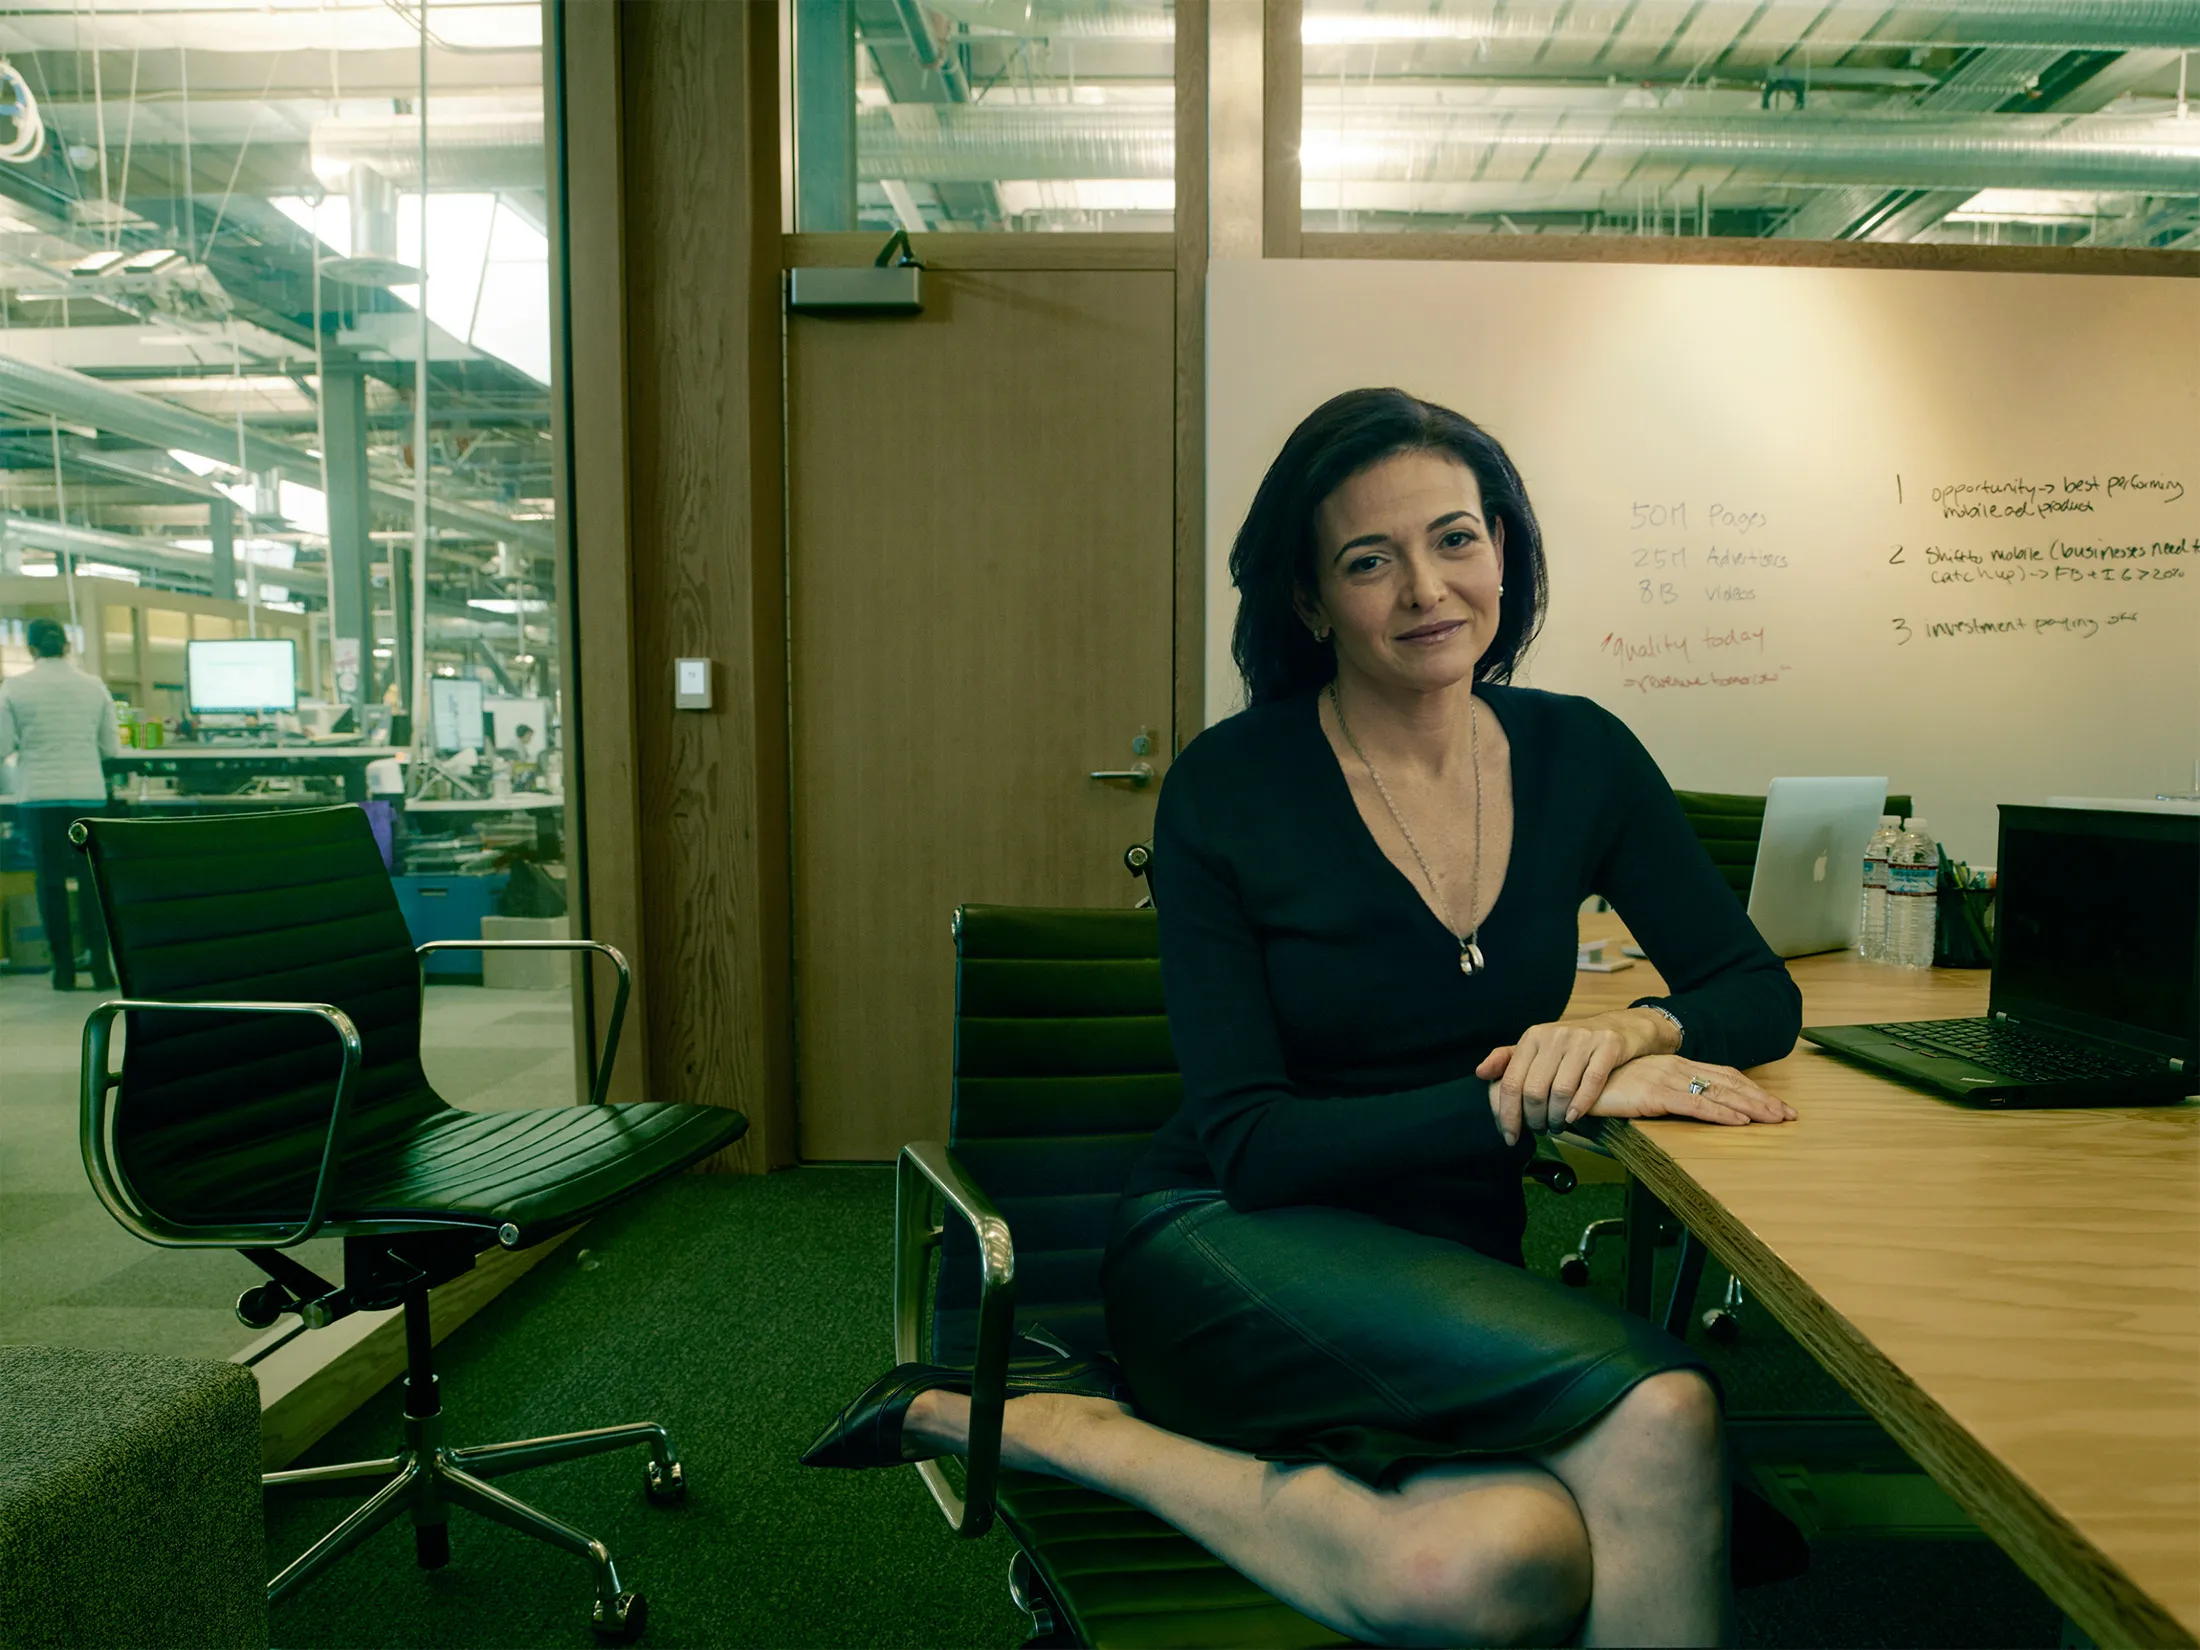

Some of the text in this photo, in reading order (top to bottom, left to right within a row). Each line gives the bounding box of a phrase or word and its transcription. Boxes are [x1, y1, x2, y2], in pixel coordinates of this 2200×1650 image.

[1931, 477, 2036, 508] opportunity
[2064, 475, 2100, 494] best
[2107, 472, 2185, 504] performing
[1630, 502, 1768, 534] 50M Pages
[1944, 498, 2095, 519] mobile ad product
[1631, 546, 1789, 569] 25M Advertisers
[1889, 544, 1906, 565] 2
[1990, 545, 2044, 562] mobile
[2151, 537, 2190, 557] need
[2055, 565, 2084, 581] FB
[1638, 578, 1679, 605] 8B
[1702, 627, 1765, 654] today
[1892, 618, 1913, 646] 3
[1926, 617, 2027, 638] investment
[2035, 616, 2099, 639] paying
